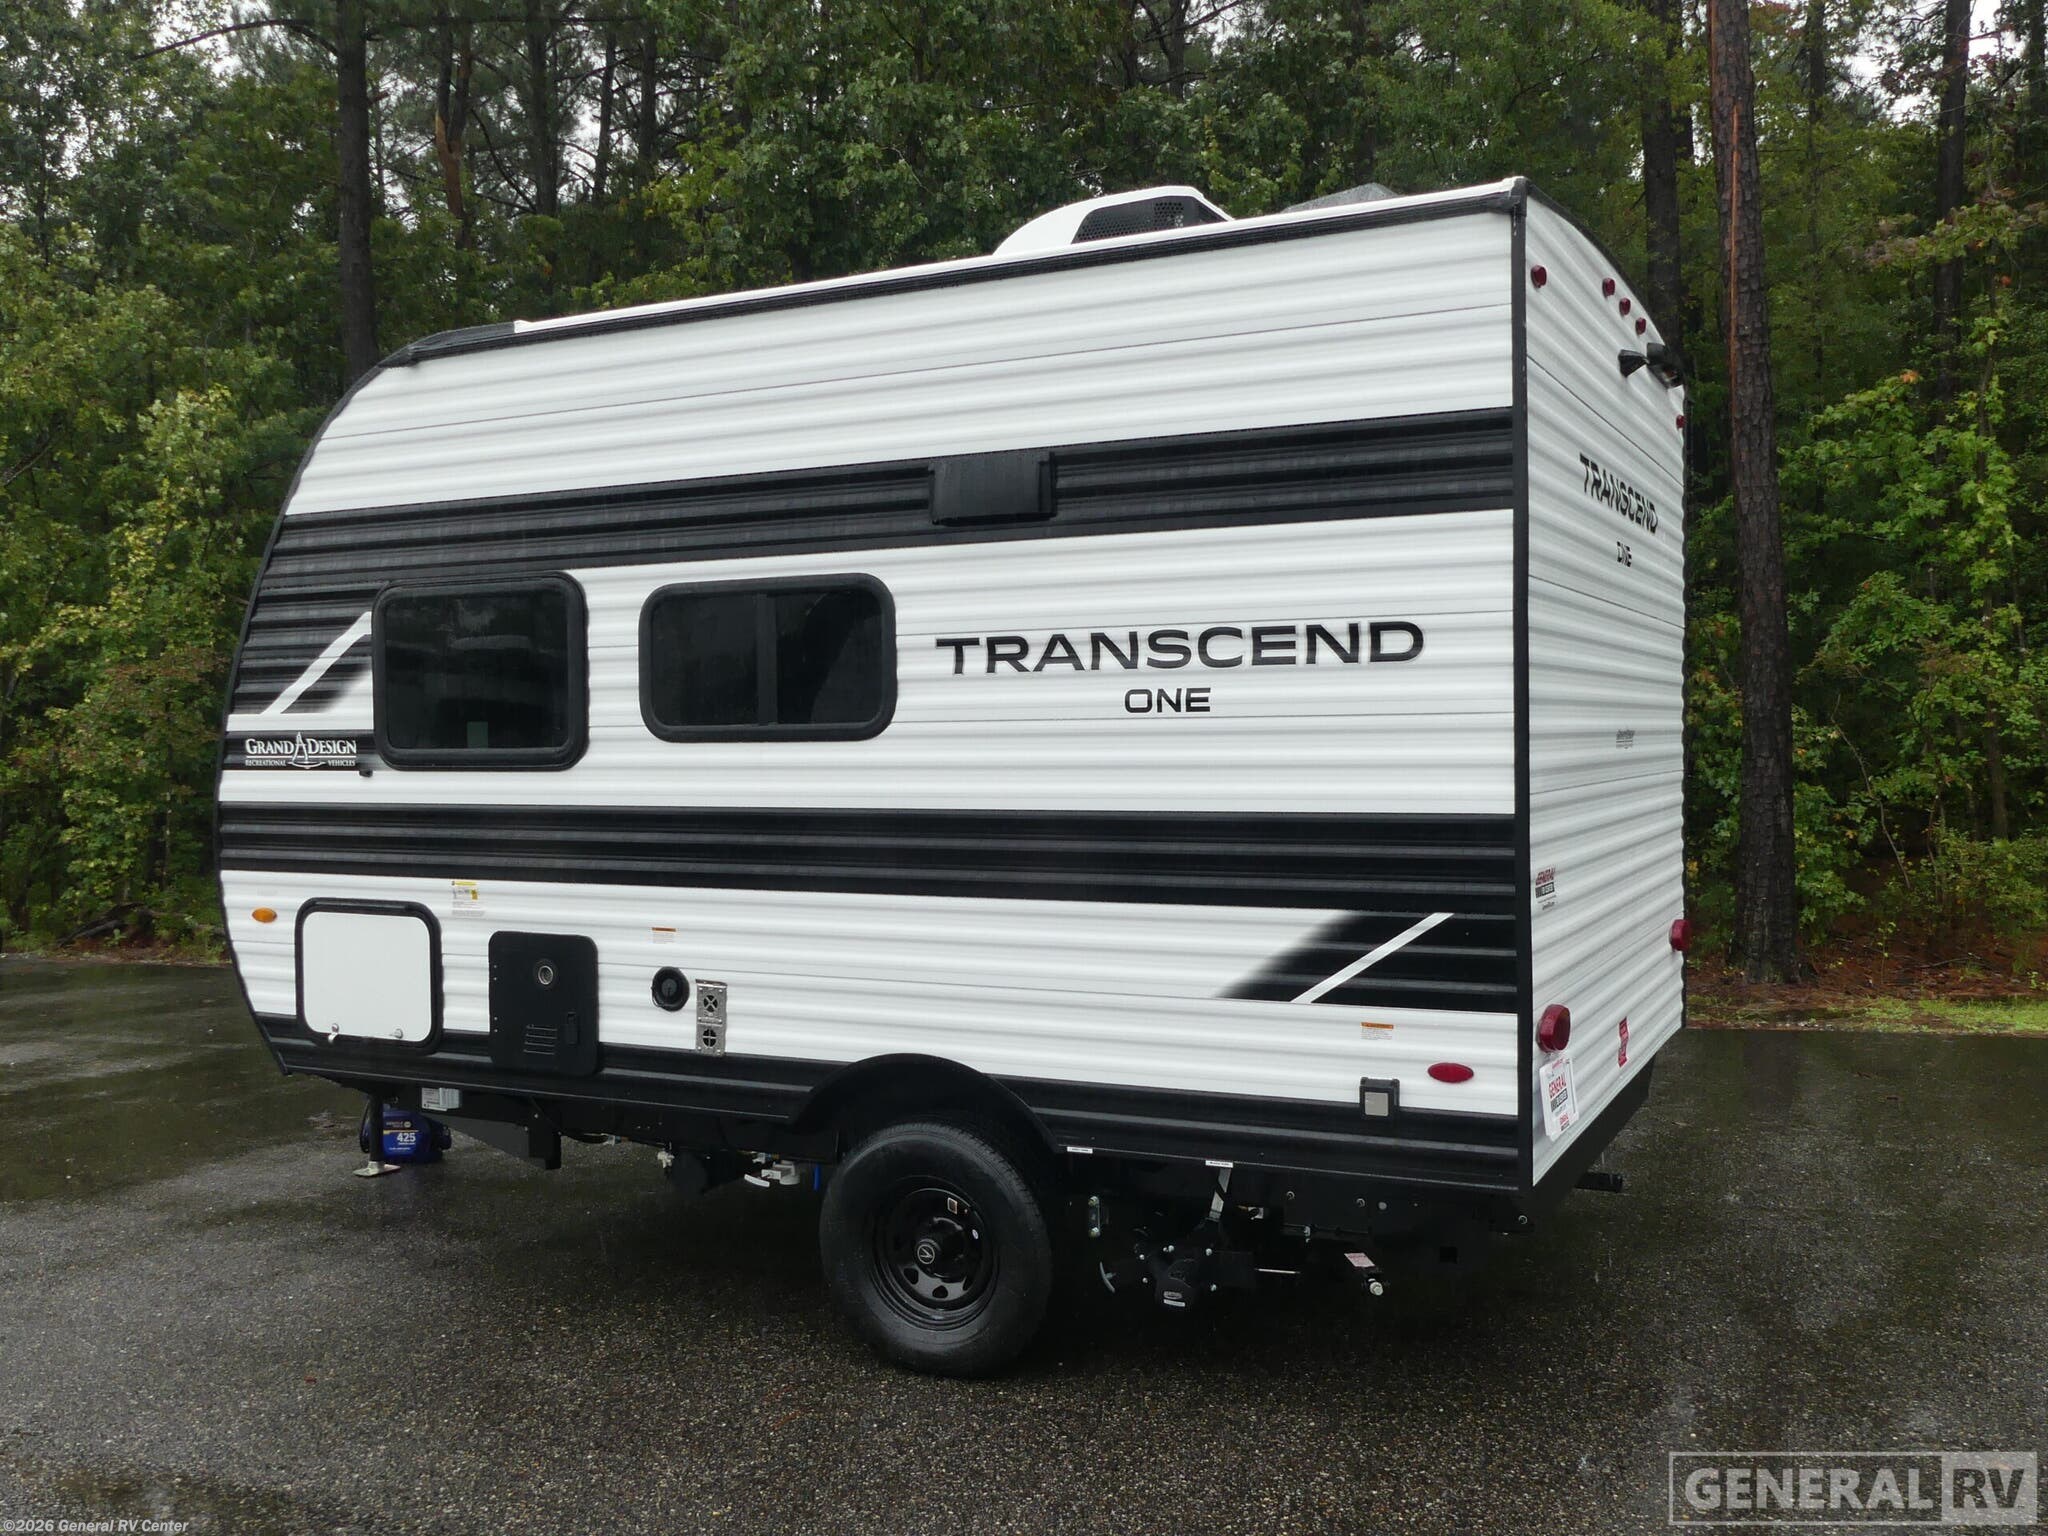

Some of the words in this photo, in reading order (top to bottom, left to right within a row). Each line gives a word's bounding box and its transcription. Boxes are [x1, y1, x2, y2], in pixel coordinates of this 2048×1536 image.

[1580, 452, 1658, 534] TRANSCEND
[935, 621, 1424, 675] TRANSCEND
[1124, 687, 1211, 713] ONE
[245, 738, 295, 754] GRAND
[306, 738, 357, 754] DESIGN
[245, 759, 287, 767] RECREATIONAL
[327, 759, 356, 767] VEHICLES
[396, 1132, 416, 1143] 425
